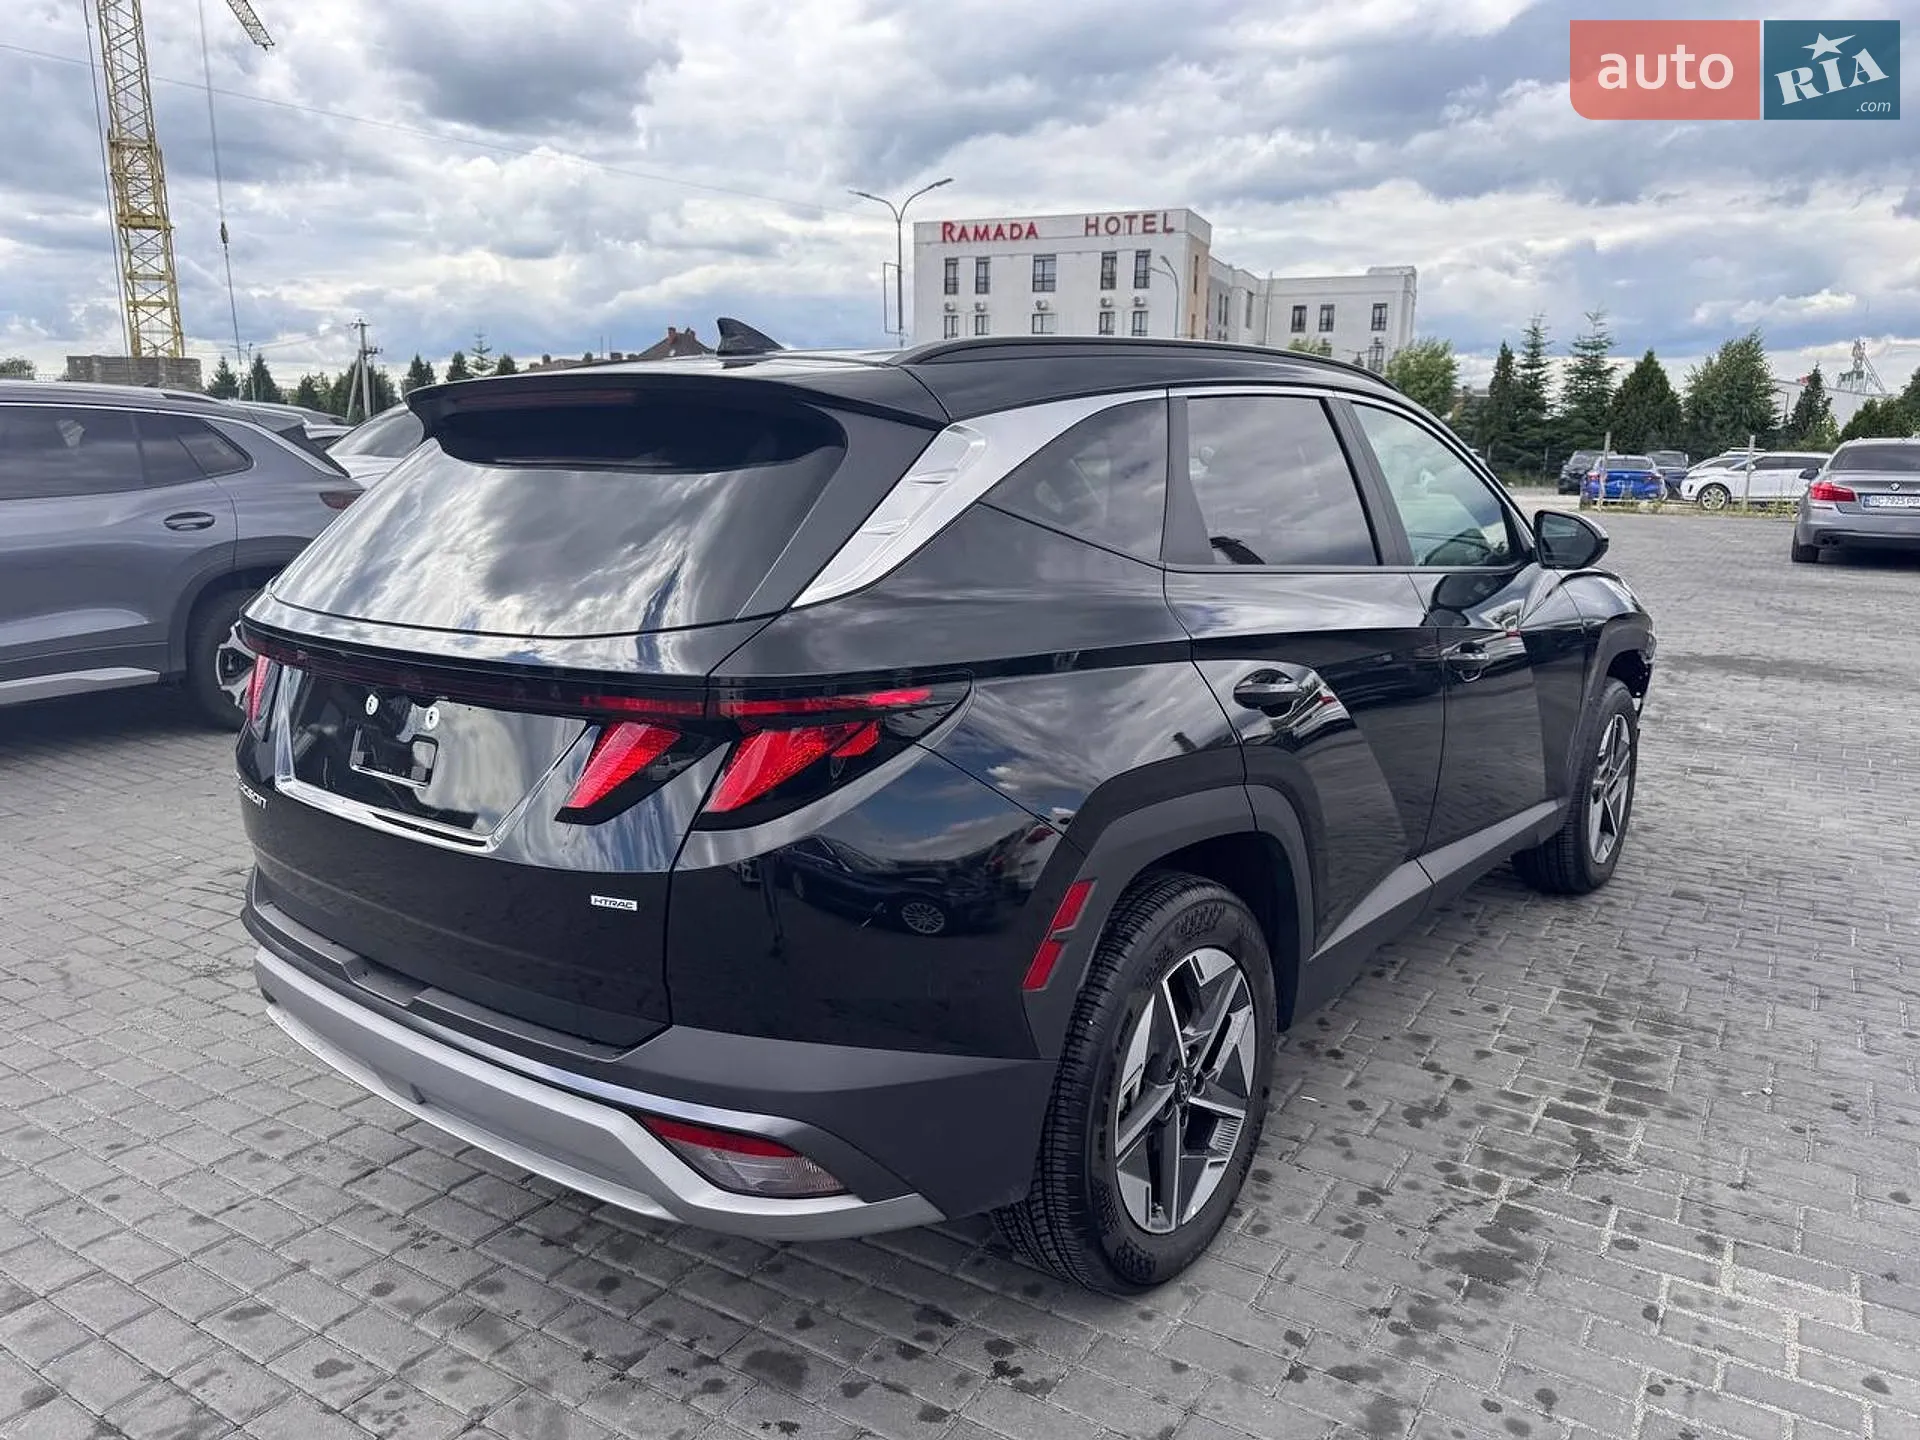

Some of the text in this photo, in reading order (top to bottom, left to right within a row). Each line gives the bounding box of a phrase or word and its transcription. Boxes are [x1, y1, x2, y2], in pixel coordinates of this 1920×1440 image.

[941, 212, 1176, 244] RAMADA HOTEL
[592, 896, 636, 910] HTRAC
